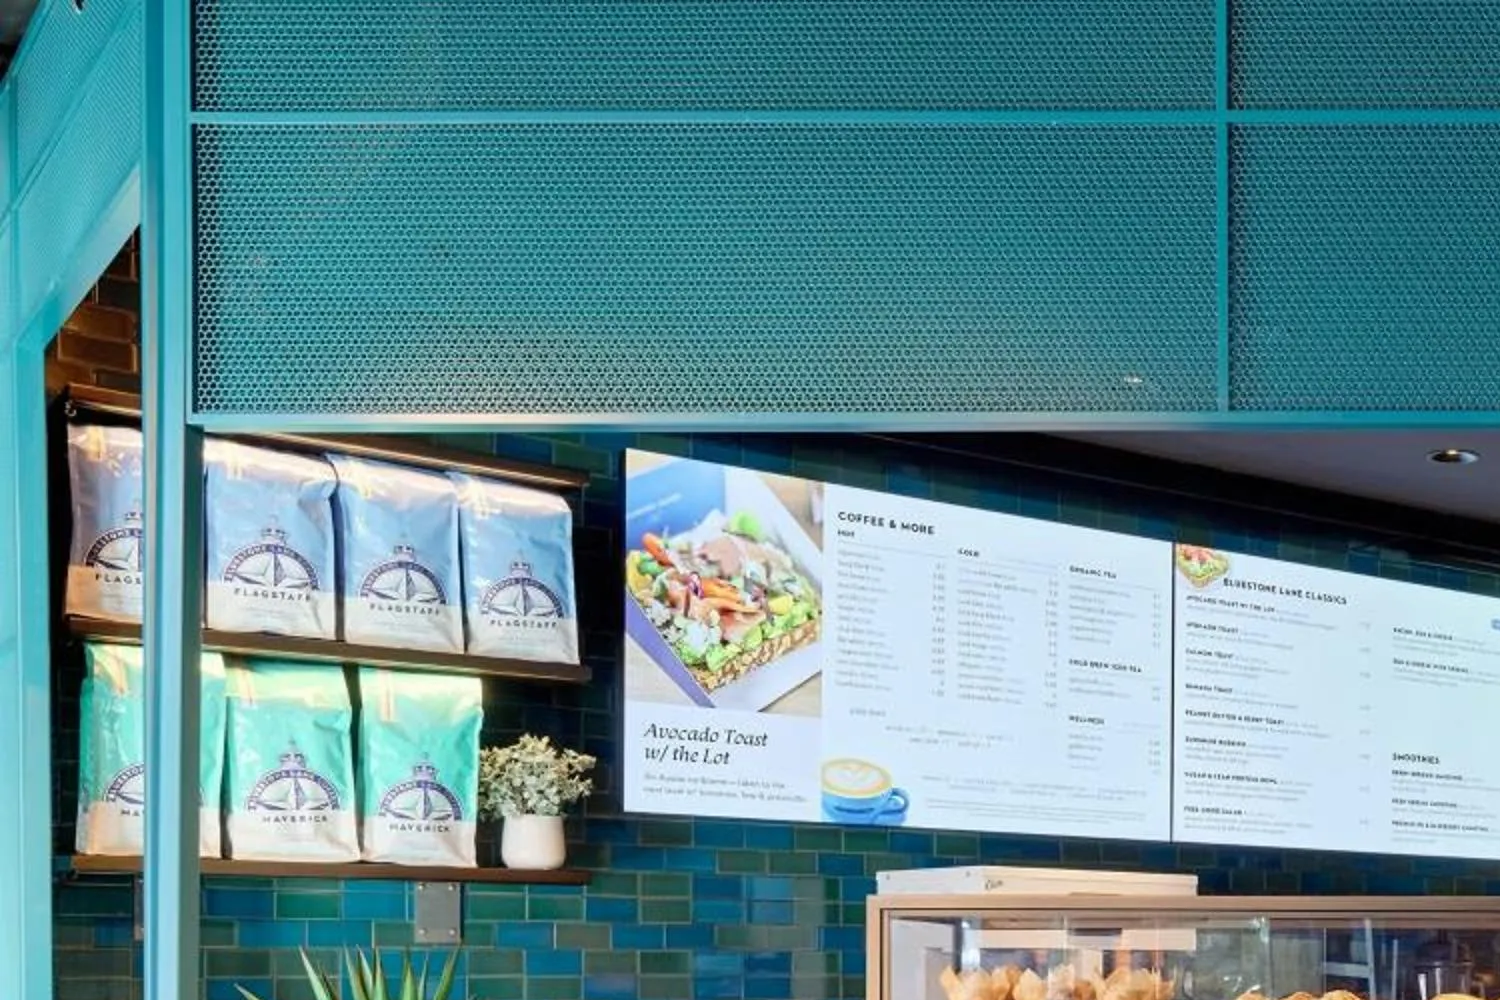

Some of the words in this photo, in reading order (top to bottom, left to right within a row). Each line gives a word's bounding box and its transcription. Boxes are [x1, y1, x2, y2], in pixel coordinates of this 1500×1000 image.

[838, 511, 885, 528] COFFEE
[889, 519, 897, 529] &
[900, 521, 936, 535] MORE
[95, 572, 142, 585] FLAGS
[643, 723, 719, 743] Avocado
[724, 729, 768, 747] Toast
[645, 746, 669, 763] w/
[673, 746, 698, 763] the
[703, 749, 730, 765] Lot
